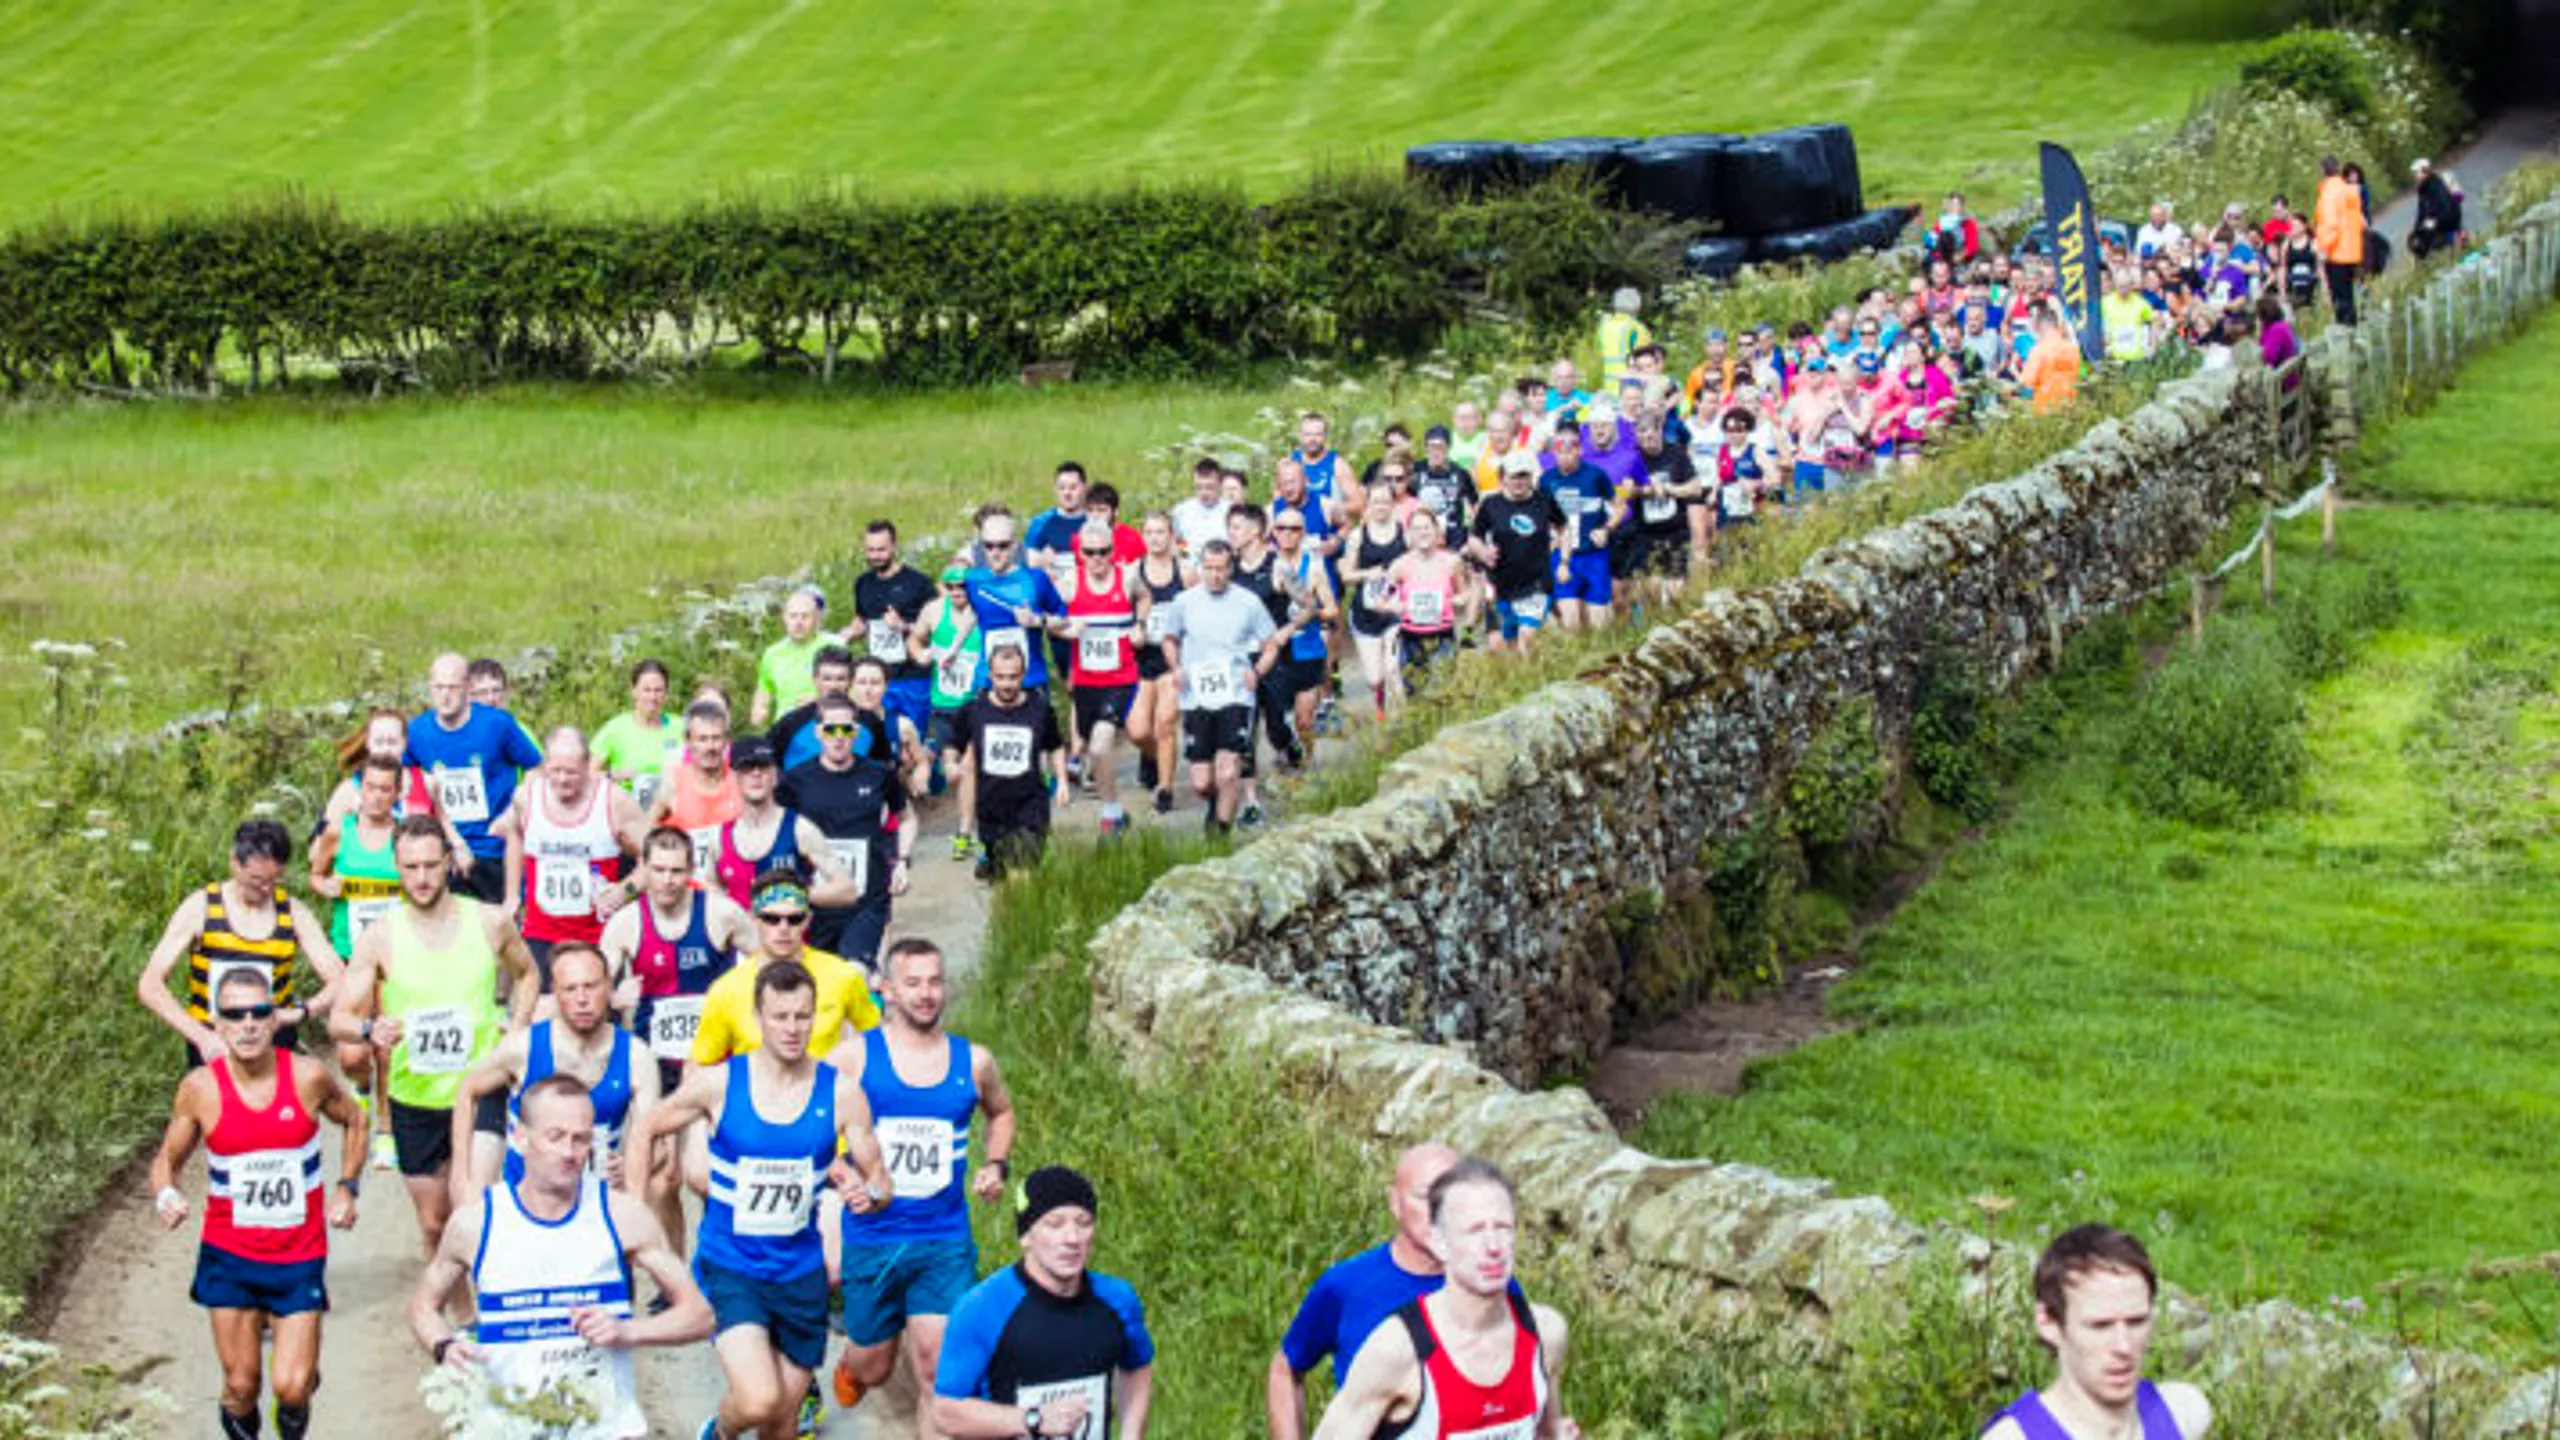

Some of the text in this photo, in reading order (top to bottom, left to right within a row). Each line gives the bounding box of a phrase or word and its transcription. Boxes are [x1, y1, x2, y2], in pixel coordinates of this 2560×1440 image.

[991, 739, 1024, 762] 602
[444, 784, 479, 807] 614
[414, 1026, 465, 1055] 742
[889, 1142, 941, 1175] 704
[242, 1176, 294, 1210] 760
[749, 1183, 803, 1213] 779
